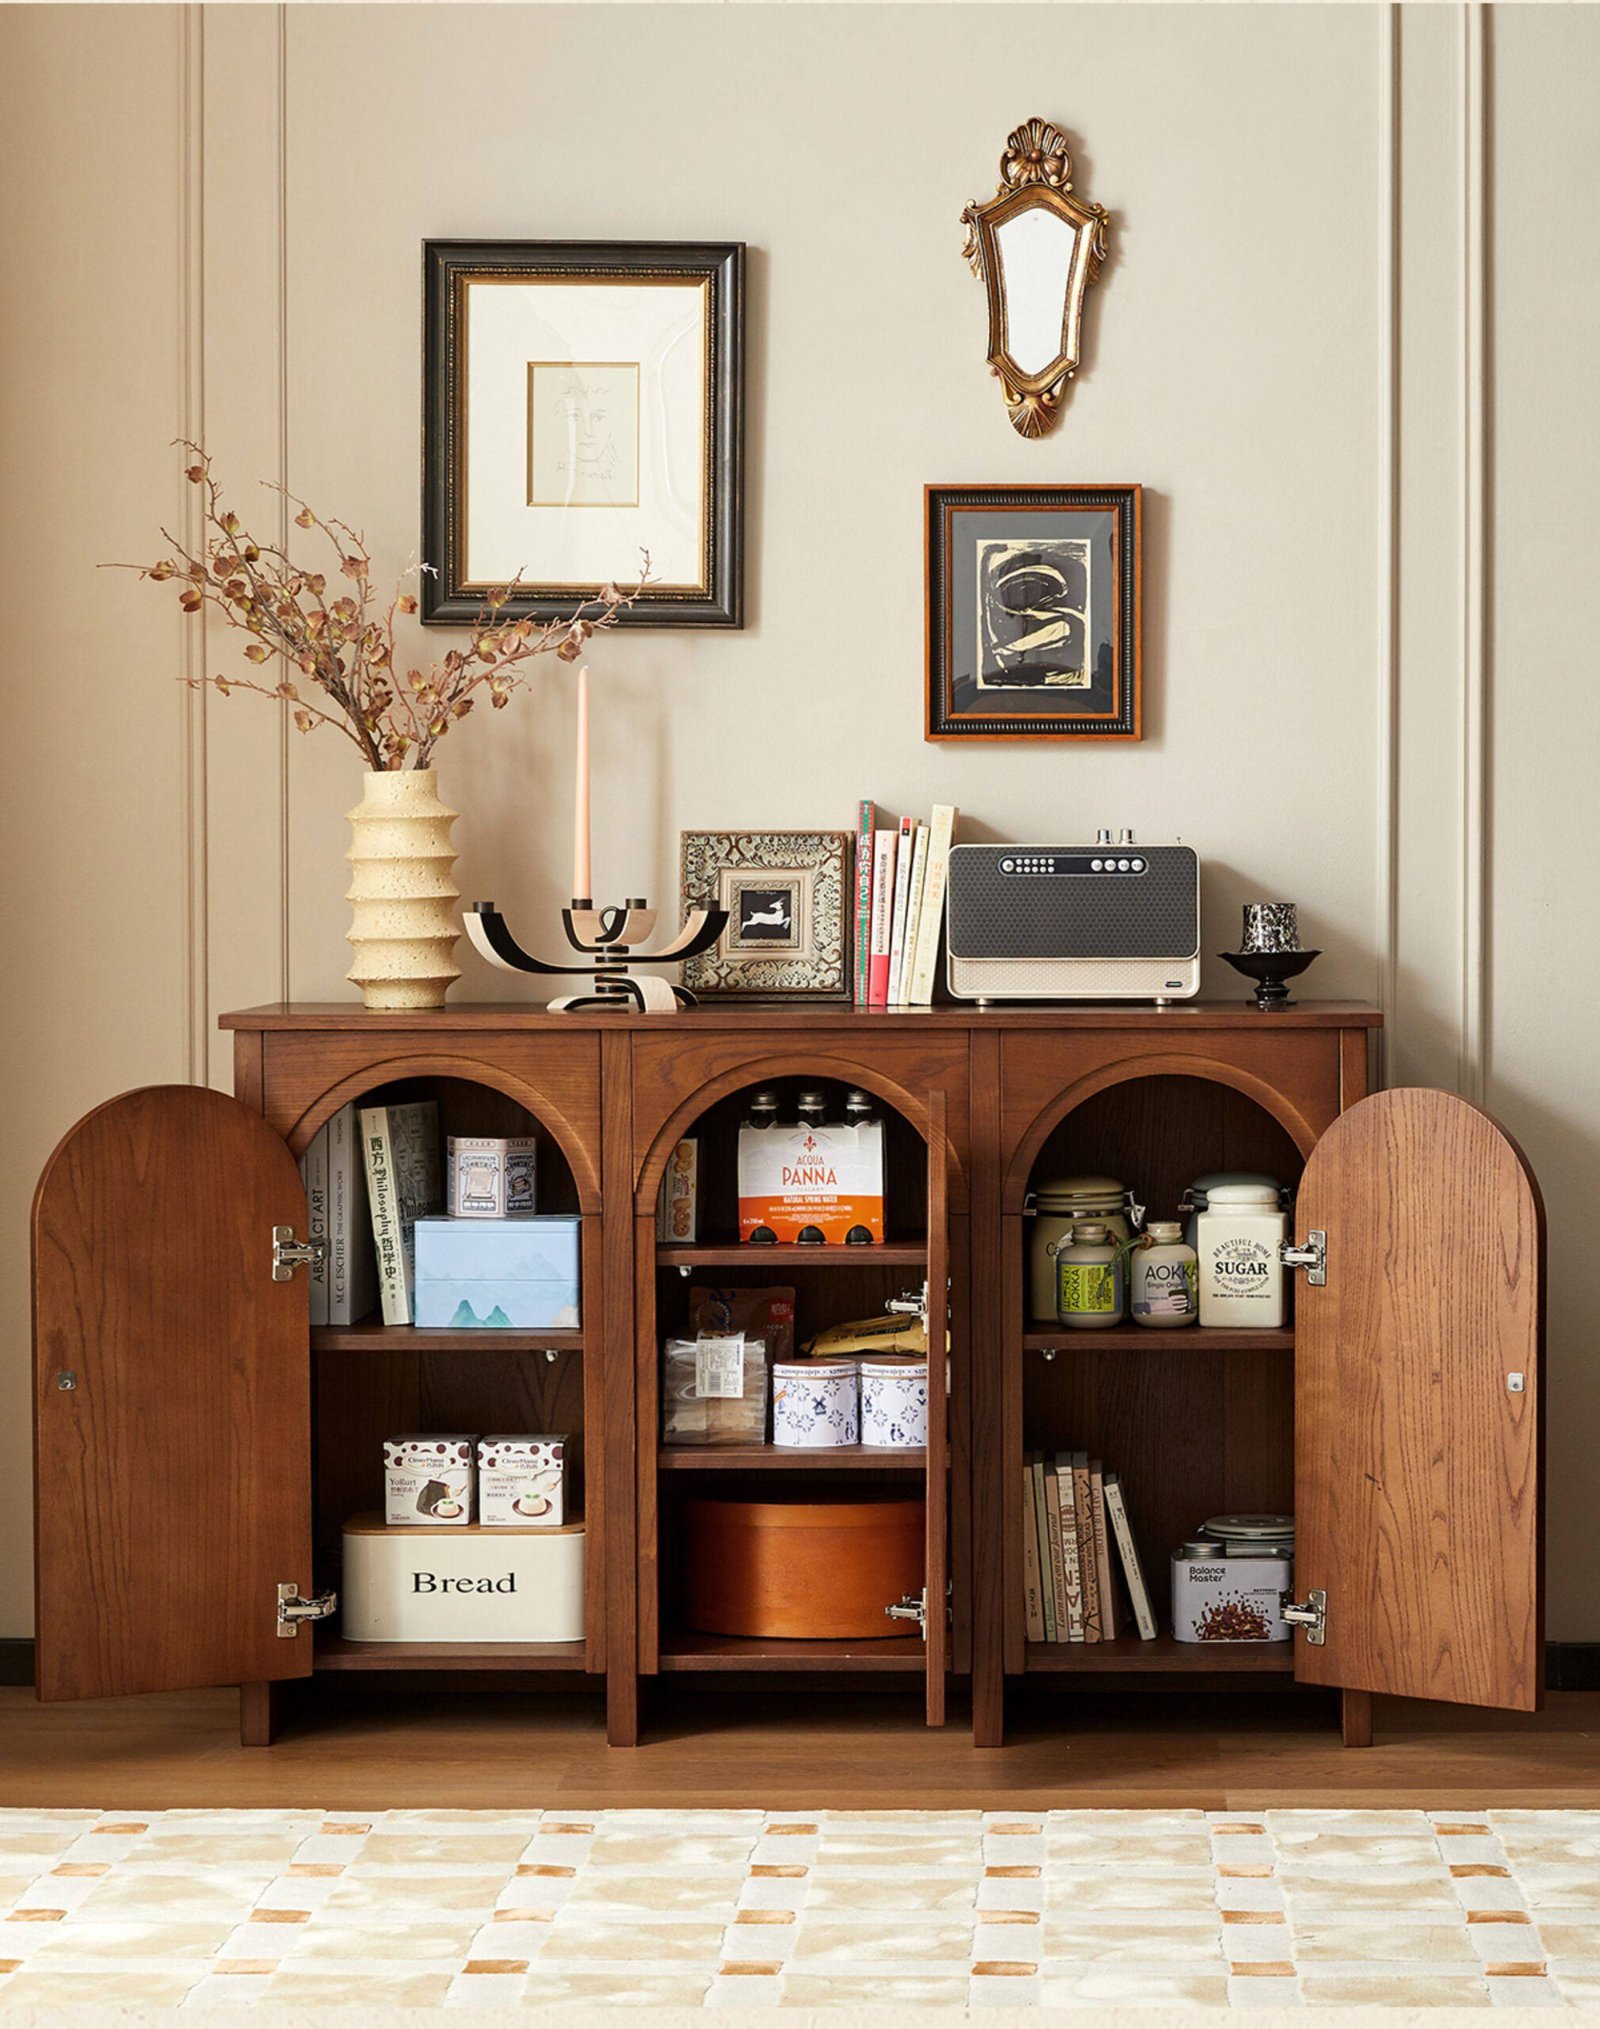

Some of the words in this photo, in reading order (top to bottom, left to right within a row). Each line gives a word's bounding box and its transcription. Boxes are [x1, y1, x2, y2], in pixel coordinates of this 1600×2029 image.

[859, 833, 871, 901] 成为你自己
[796, 1154, 825, 1166] ACQUA
[782, 1167, 837, 1186] PANNA
[312, 1188, 324, 1214] ART
[370, 1136, 385, 1167] 西方
[380, 1237, 398, 1282] 哲学史
[804, 1196, 821, 1204] SPRING
[312, 1215, 325, 1284] ABSCT
[335, 1238, 346, 1279] ESCHER
[1213, 1238, 1253, 1258] BEAUTIFUL
[1253, 1242, 1273, 1259] HOME
[1145, 1265, 1196, 1281] AOKKA
[1214, 1261, 1269, 1276] SUGAR
[335, 1281, 346, 1305] M.C.
[1071, 1268, 1081, 1308] AOKKA
[1048, 1512, 1061, 1548] Journal
[1053, 1548, 1061, 1564] our
[1054, 1566, 1062, 1577] on
[1189, 1566, 1226, 1575] Balance
[1189, 1575, 1223, 1583] Master
[411, 1572, 517, 1594] Bread
[1055, 1577, 1063, 1600] more
[1056, 1600, 1066, 1629] Learn
